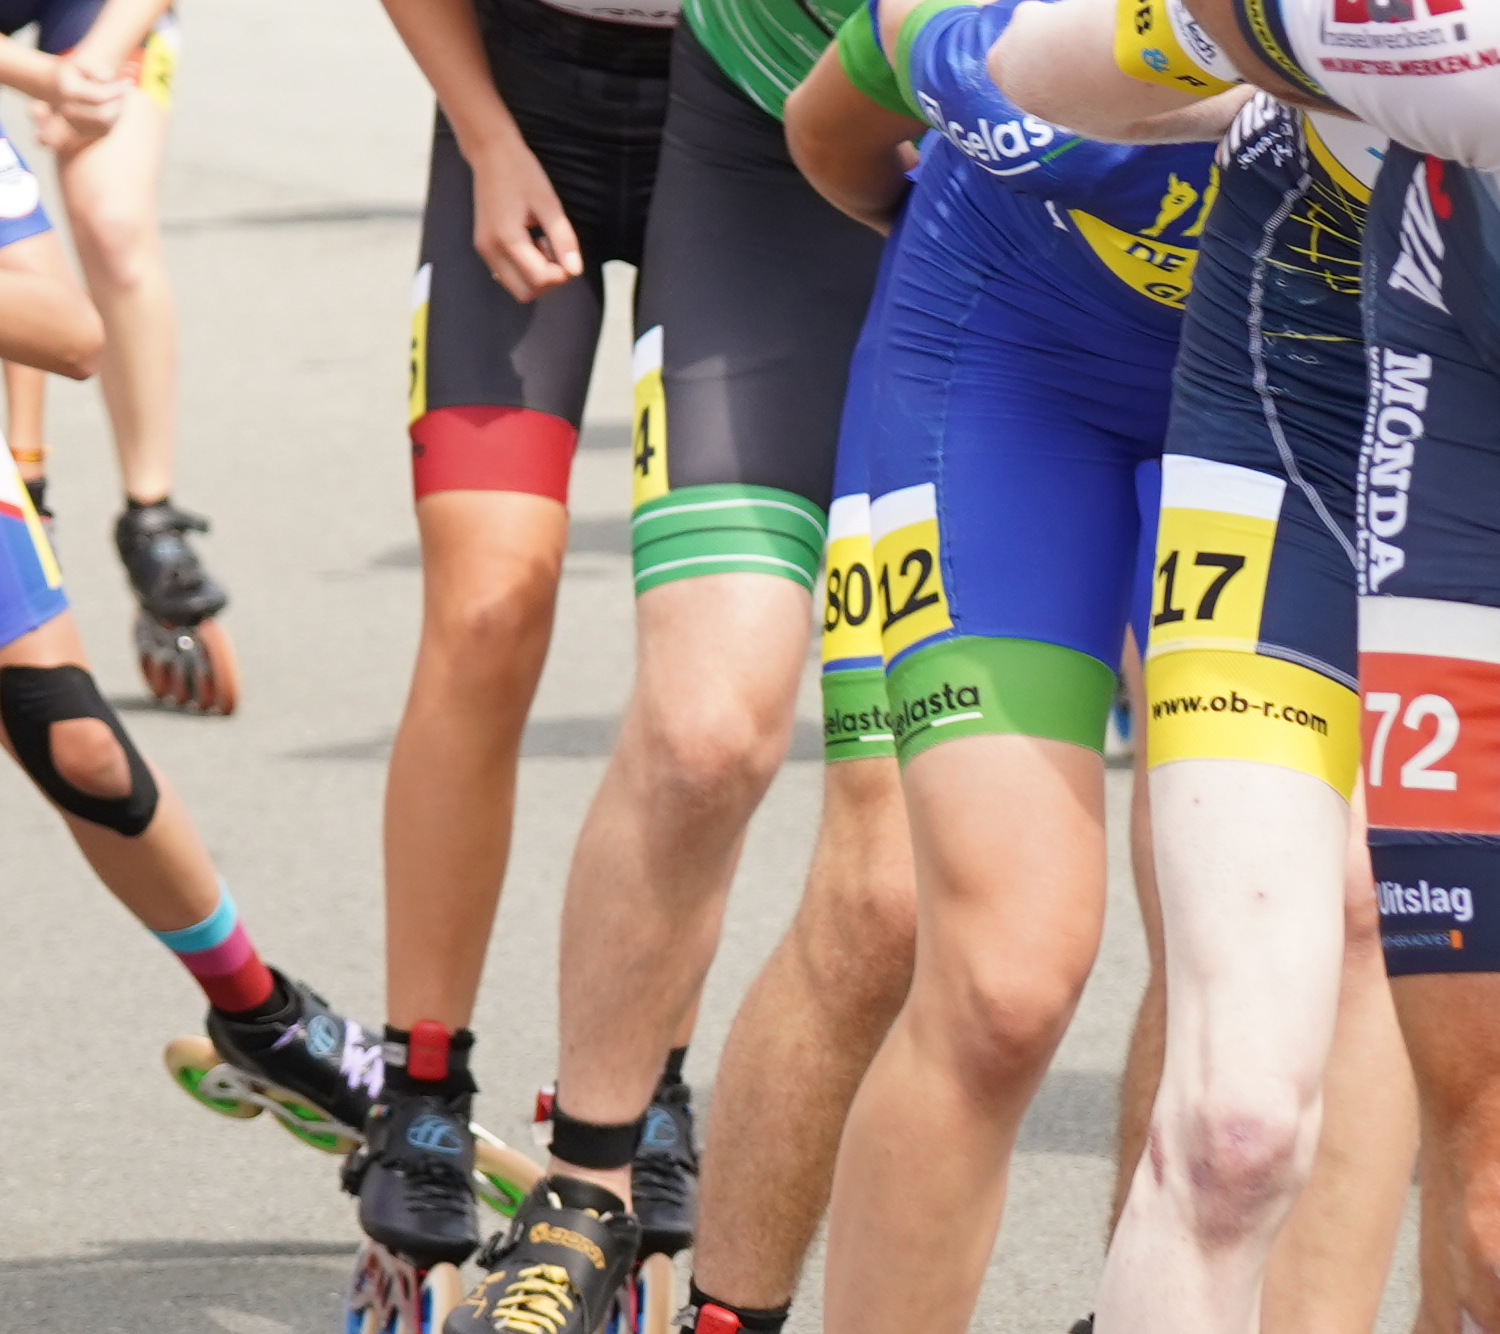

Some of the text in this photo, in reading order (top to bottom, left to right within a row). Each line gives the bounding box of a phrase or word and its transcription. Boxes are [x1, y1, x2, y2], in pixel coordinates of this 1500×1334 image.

[1368, 345, 1433, 594] MONDA
[878, 548, 940, 635] 12
[1152, 550, 1246, 628] 17
[1151, 689, 1329, 736] www.ob-r.com
[1364, 691, 1461, 792] 72
